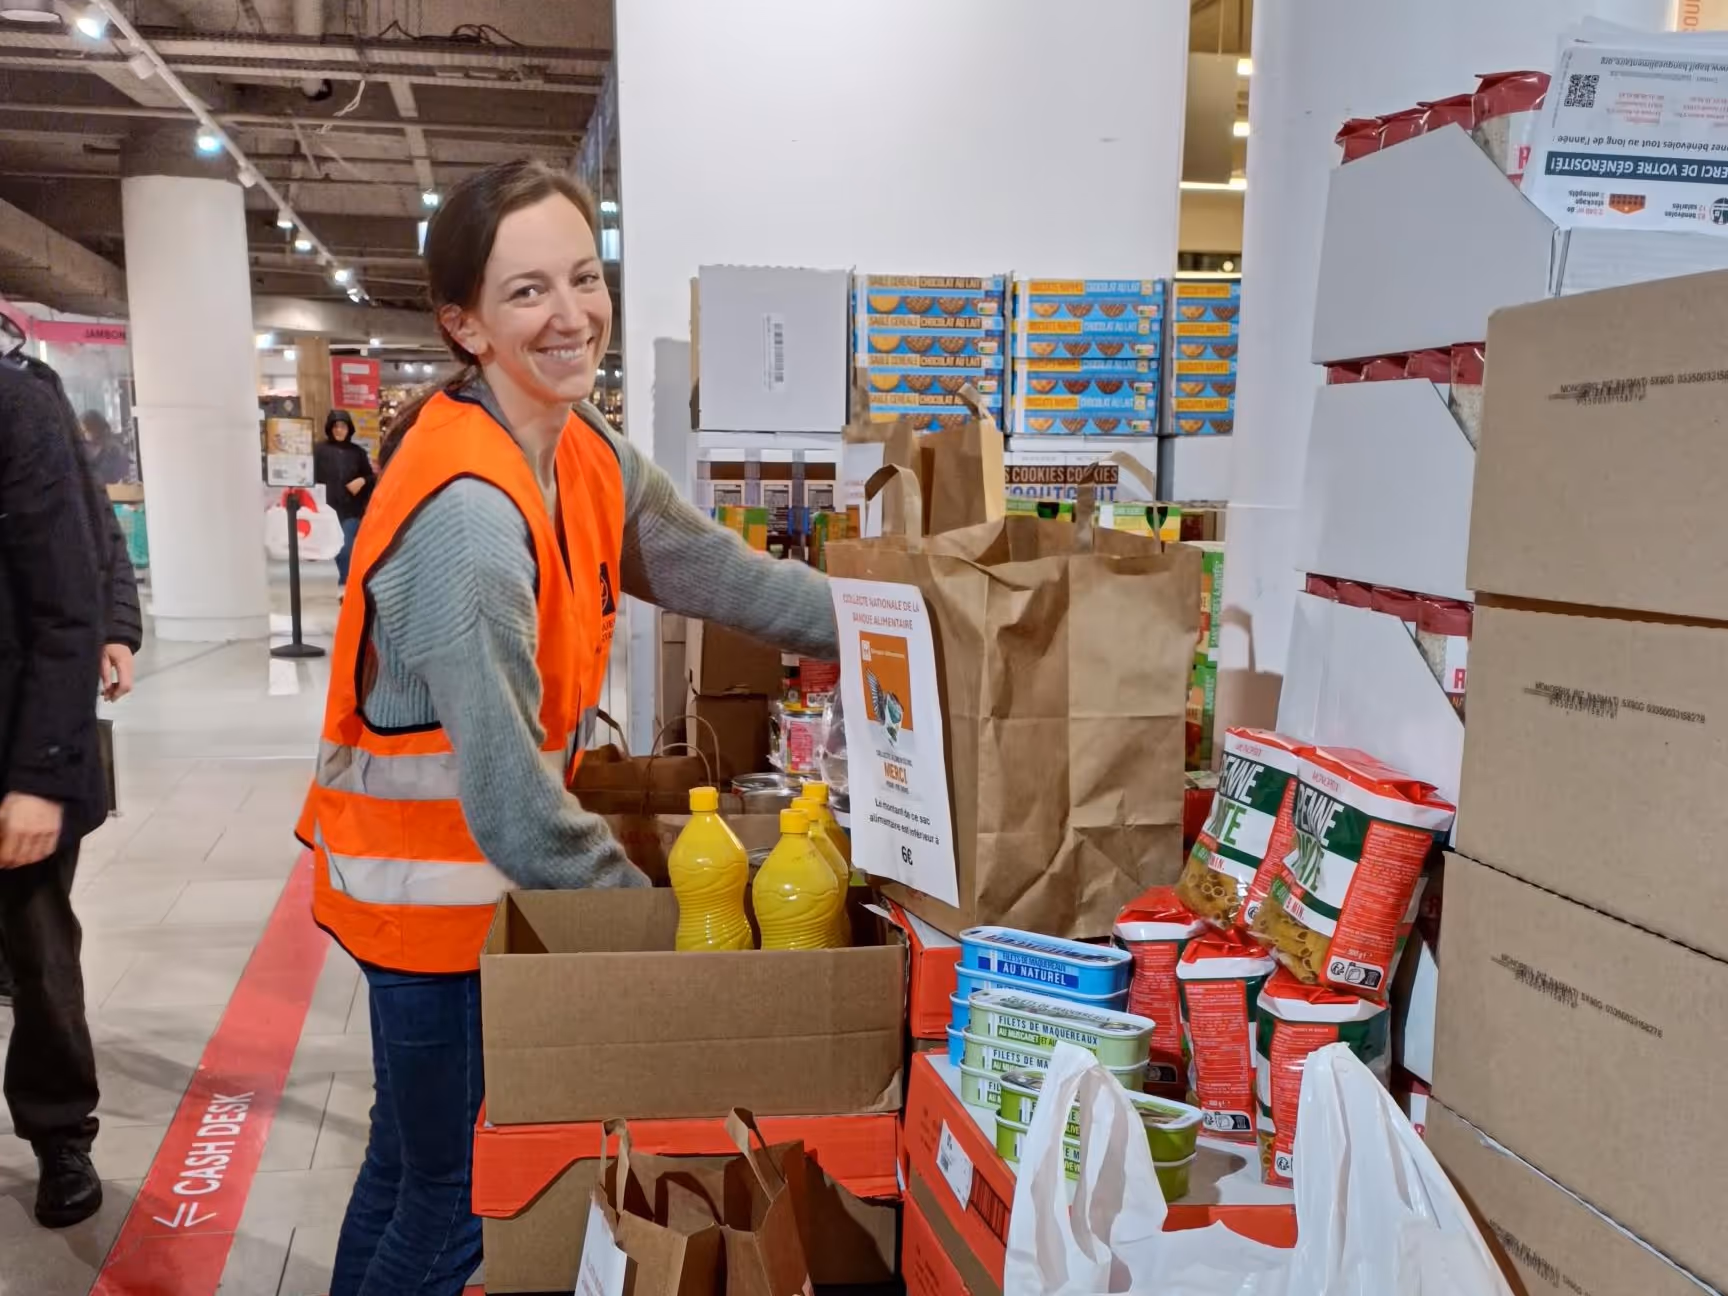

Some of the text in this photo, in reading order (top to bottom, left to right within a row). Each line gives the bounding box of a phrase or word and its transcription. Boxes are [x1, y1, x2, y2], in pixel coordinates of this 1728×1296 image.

[1557, 135, 1591, 146] l'année
[1592, 136, 1604, 145] de
[1606, 135, 1626, 147] long
[1628, 139, 1639, 147] au
[1642, 138, 1661, 148] tout
[1663, 140, 1708, 151] bénévoles
[1636, 161, 1678, 176] VOTRE
[1681, 163, 1699, 177] DE
[1701, 164, 1728, 179] ERCI
[920, 279, 955, 288] CHOCOLAT
[955, 279, 965, 288] AU
[966, 279, 980, 288] LAIT
[920, 318, 955, 328] CHOCOLAT
[955, 318, 965, 328] AU
[966, 318, 980, 328] LAIT
[920, 357, 955, 366] CHOCOLAT
[955, 357, 965, 366] AU
[966, 357, 980, 366] LAIT
[920, 395, 955, 405] CHOCOLAT
[1011, 466, 1065, 483] COOKIES
[870, 597, 902, 611] NATIONALE
[903, 601, 912, 612] DE
[912, 601, 920, 613] LA
[874, 616, 914, 630] ALIMENTAIRE
[883, 761, 908, 785] MERCI
[874, 797, 882, 807] Le
[911, 813, 919, 822] ce
[919, 815, 931, 826] sac
[901, 845, 914, 866] 6€
[1291, 902, 1305, 921] MIN.
[1002, 962, 1067, 986] AU NATUREL
[998, 1015, 1098, 1046] FILETS DE MAQUEREAUX
[1041, 1036, 1048, 1045] ET
[993, 1049, 1021, 1063] FILETS
[1023, 1055, 1034, 1066] DE
[1037, 1058, 1049, 1069] MA
[988, 1081, 1001, 1092] FIL
[172, 1091, 256, 1196] CASH DESK
